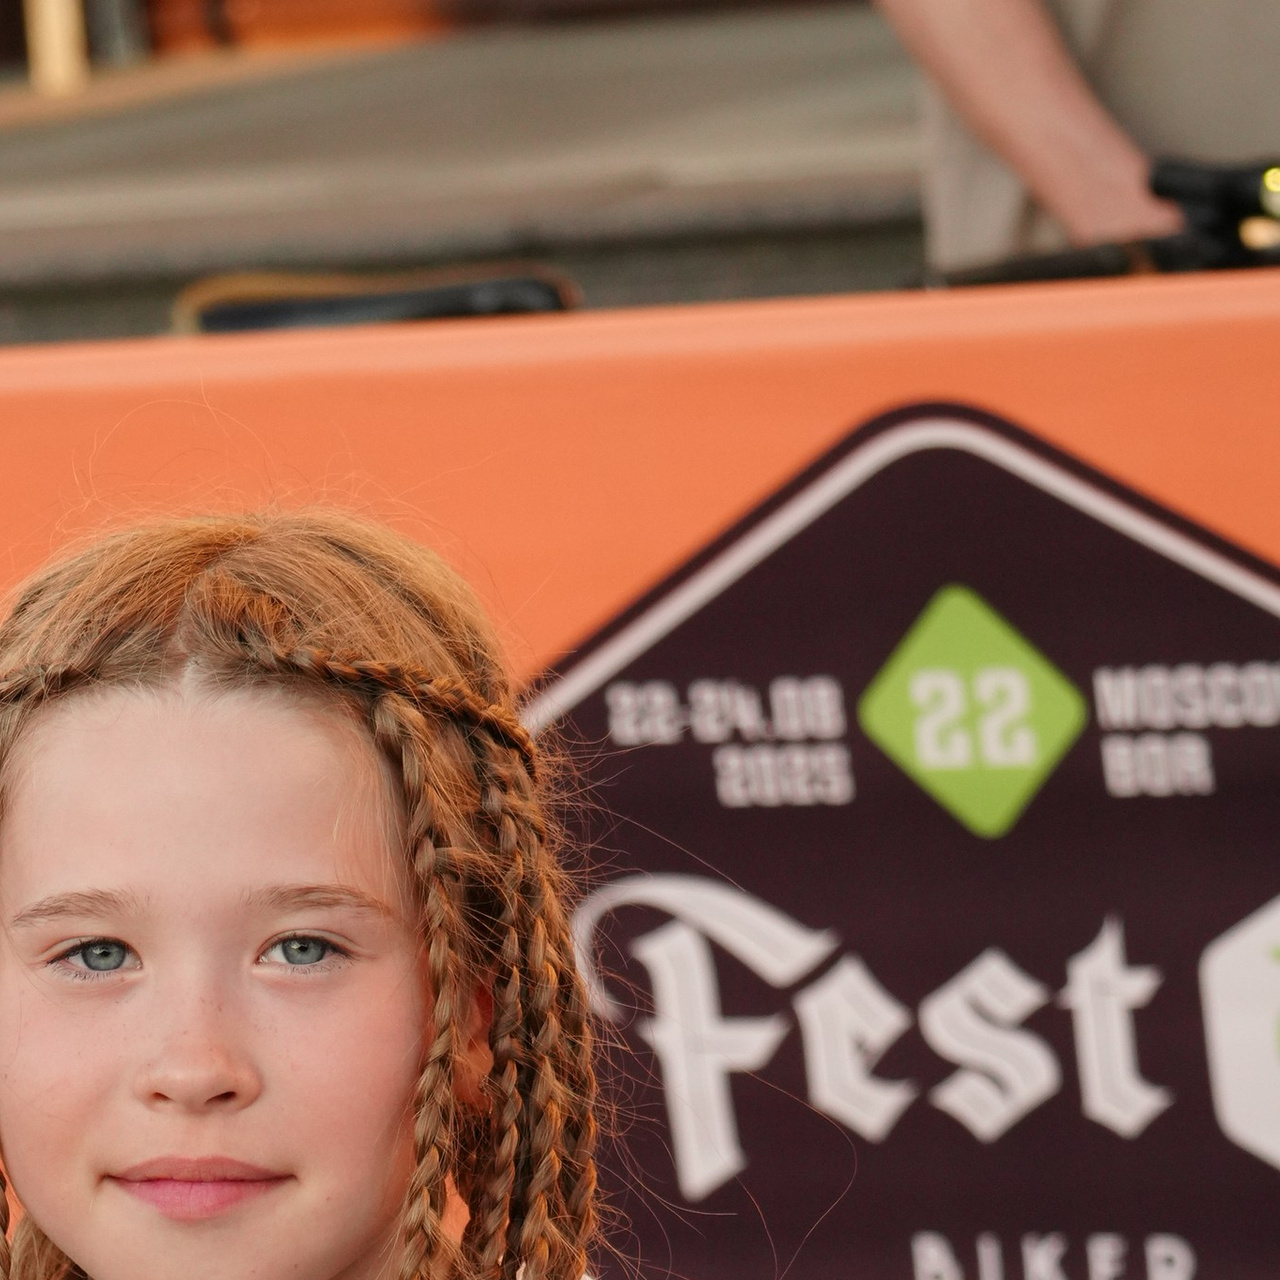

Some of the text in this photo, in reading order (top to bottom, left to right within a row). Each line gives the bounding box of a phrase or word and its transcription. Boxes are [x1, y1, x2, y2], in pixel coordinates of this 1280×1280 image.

[910, 667, 1037, 771] 22
[1093, 662, 1280, 730] MOSCO
[714, 743, 855, 808] 2025
[570, 872, 1174, 1200] Fest
